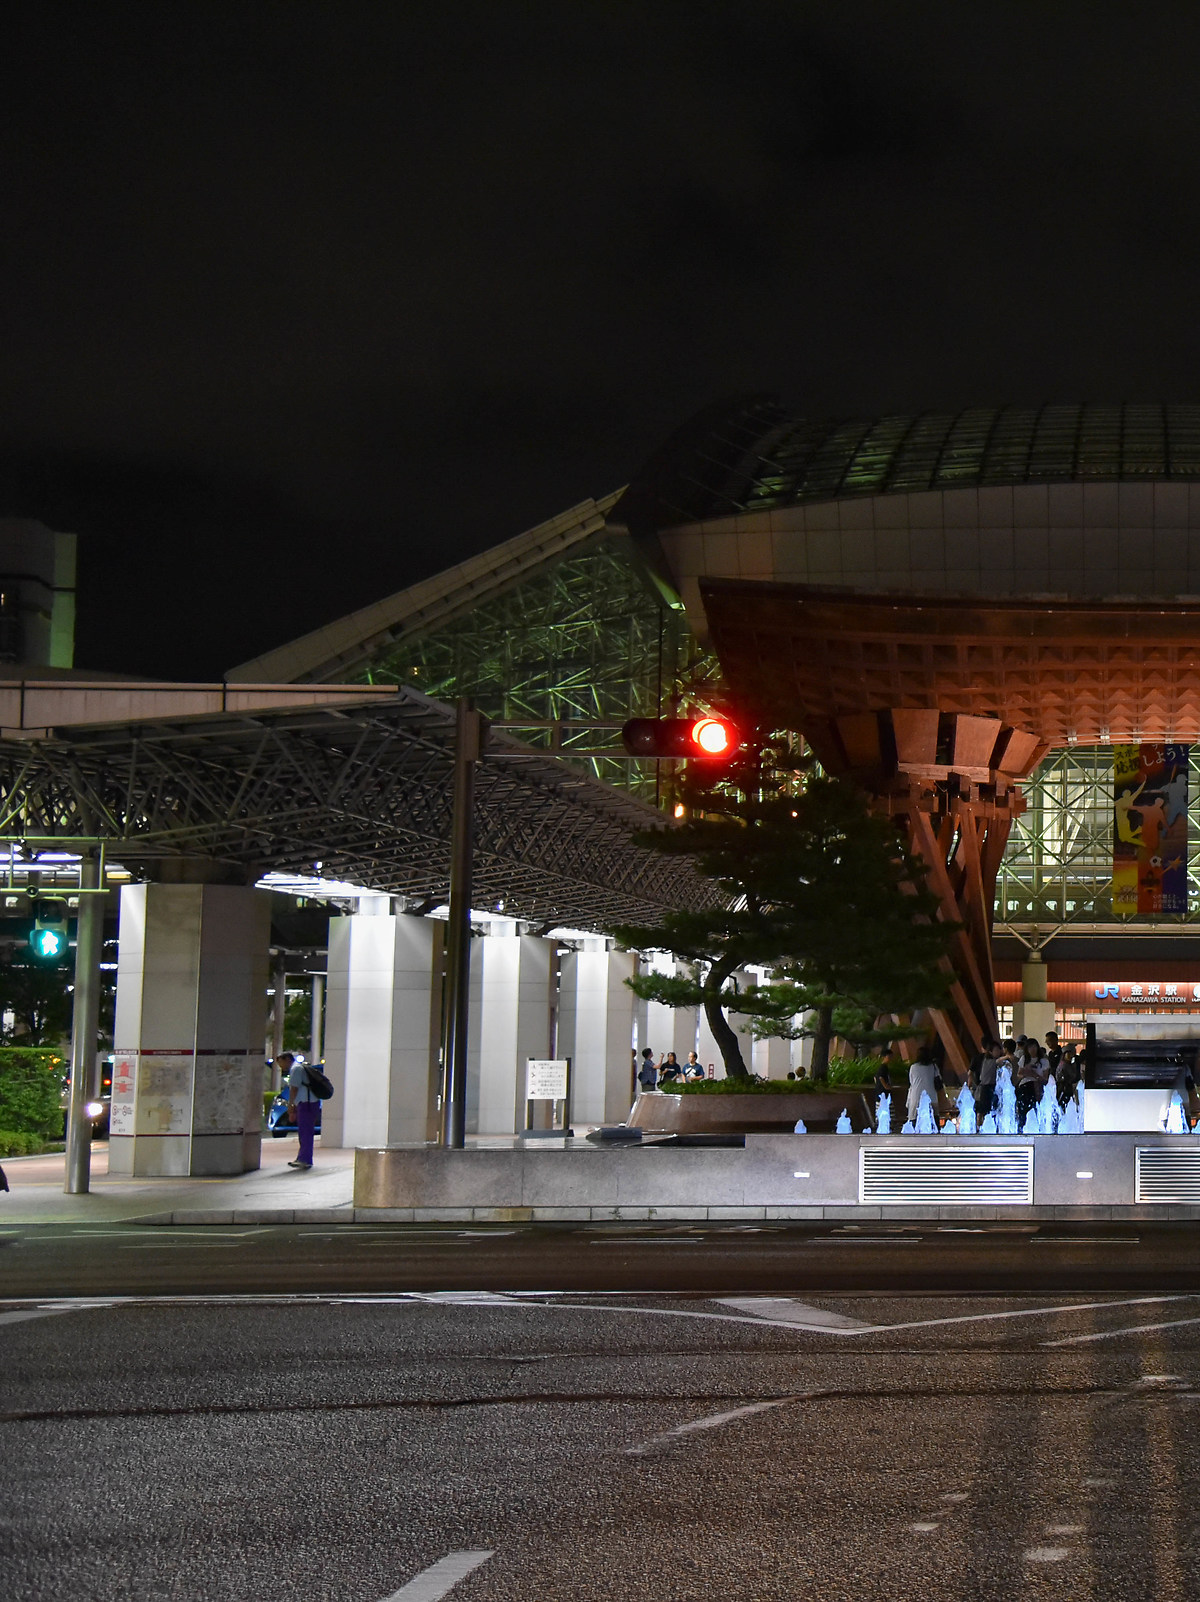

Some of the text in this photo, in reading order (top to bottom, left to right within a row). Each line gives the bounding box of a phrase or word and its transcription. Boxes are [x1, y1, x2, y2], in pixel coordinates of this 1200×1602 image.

[1095, 984, 1119, 999] JR
[1131, 984, 1177, 996] 金沢駅
